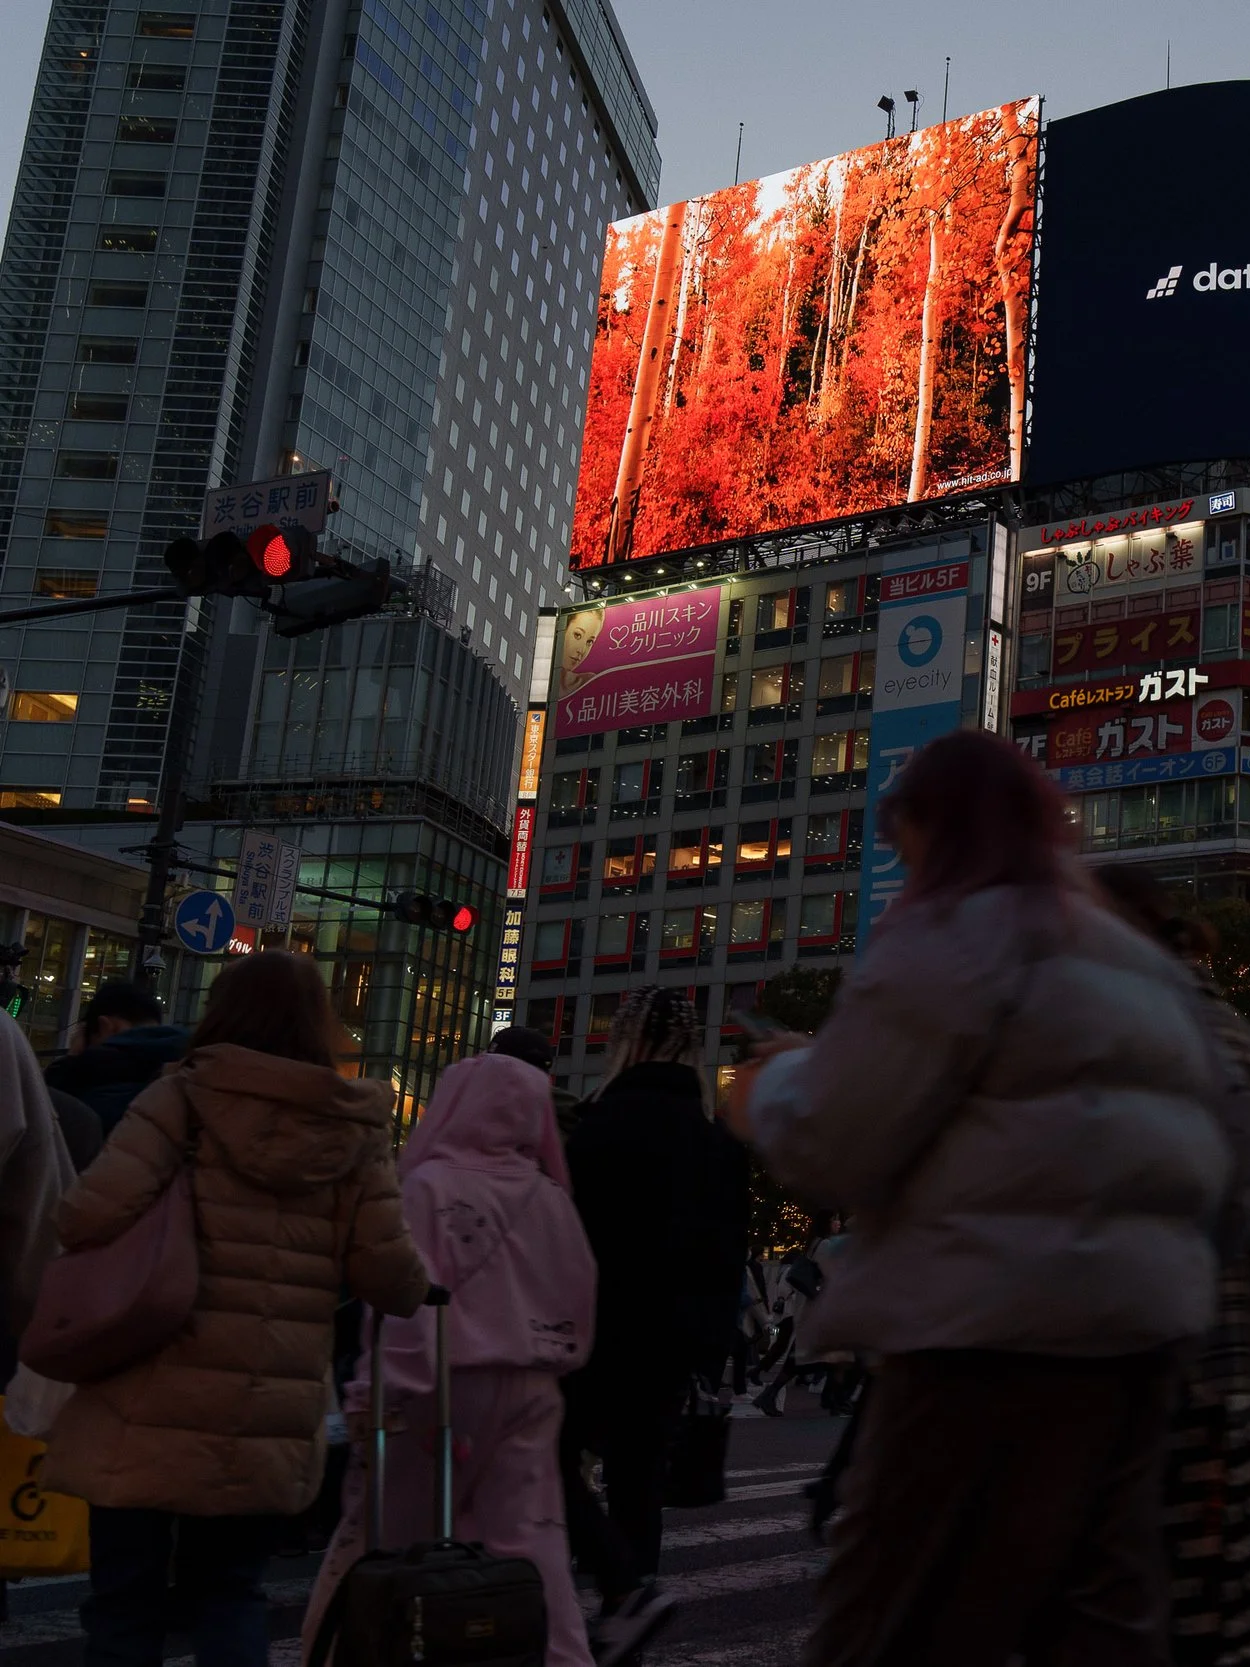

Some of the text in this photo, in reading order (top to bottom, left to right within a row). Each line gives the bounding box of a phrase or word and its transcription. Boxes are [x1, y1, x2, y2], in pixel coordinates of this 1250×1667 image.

[937, 466, 1013, 490] www.hit-ad.co.jp
[214, 481, 318, 524] 渋谷駅前
[1210, 494, 1234, 511] 寿司
[1040, 500, 1195, 545] しゃぶしゃぶバイキング
[1107, 538, 1194, 581] しゃぶ葉
[889, 567, 960, 597] 当ビル5F
[1026, 570, 1052, 593] 9F
[631, 602, 712, 634] 品川スキン
[629, 625, 701, 656] クリニック
[1055, 616, 1196, 665] プライス
[577, 677, 704, 723] 品川美容外科
[884, 668, 952, 698] eyecity
[988, 655, 999, 720] 献血ルーム
[1049, 667, 1209, 710] Caféレストラン ガスト
[1055, 726, 1093, 749] Café
[1096, 713, 1184, 760] ガスト
[1200, 717, 1231, 732] ガスト
[524, 724, 540, 790] 東京スター銀行
[1067, 754, 1196, 789] 英会話イーオン
[1204, 752, 1225, 770] 6F
[248, 841, 274, 920] 渋谷駅前
[274, 849, 297, 922] スクランブル式
[498, 909, 522, 983] 加藤眼科
[498, 988, 513, 999] 5F
[495, 1011, 511, 1021] 3F
